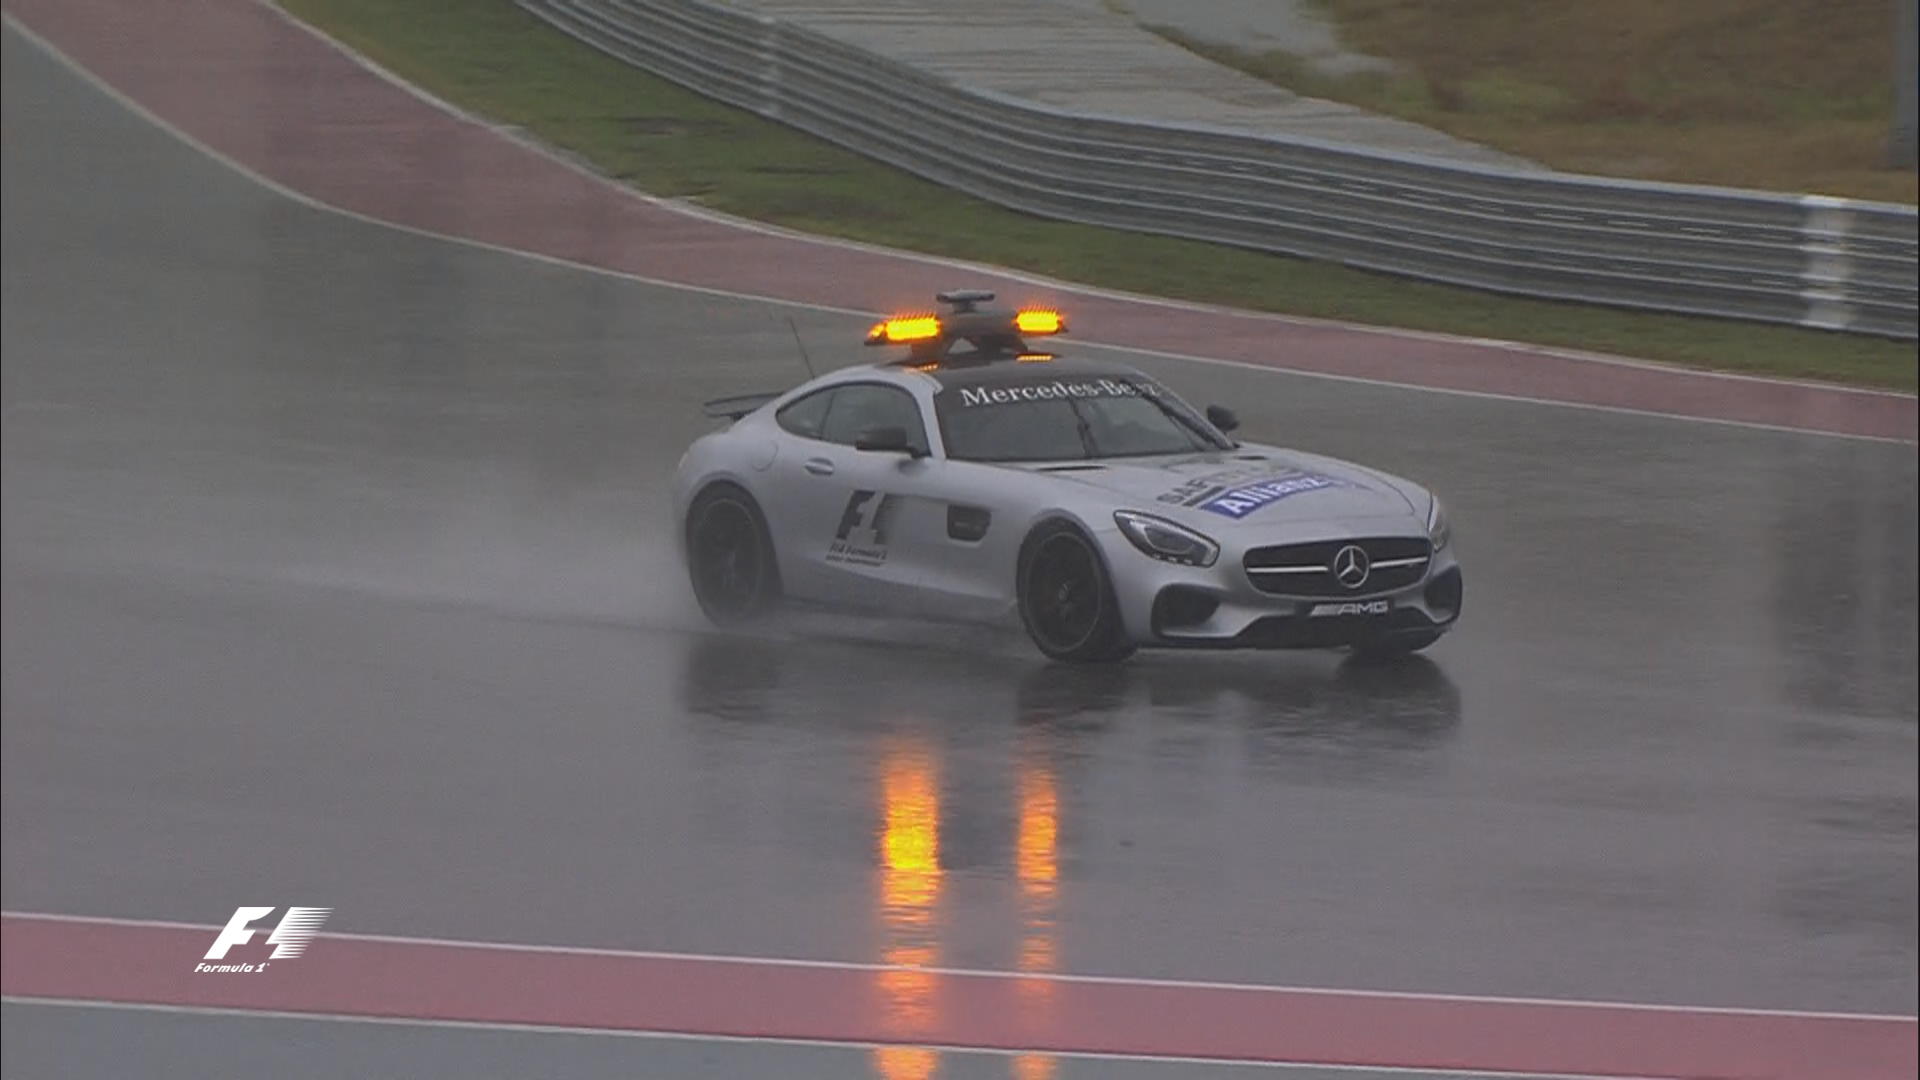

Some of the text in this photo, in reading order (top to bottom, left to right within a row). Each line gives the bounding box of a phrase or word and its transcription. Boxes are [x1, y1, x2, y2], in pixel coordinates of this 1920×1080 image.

[1214, 475, 1328, 514] Allianz
[835, 489, 905, 545] F1
[1337, 601, 1388, 616] AMG
